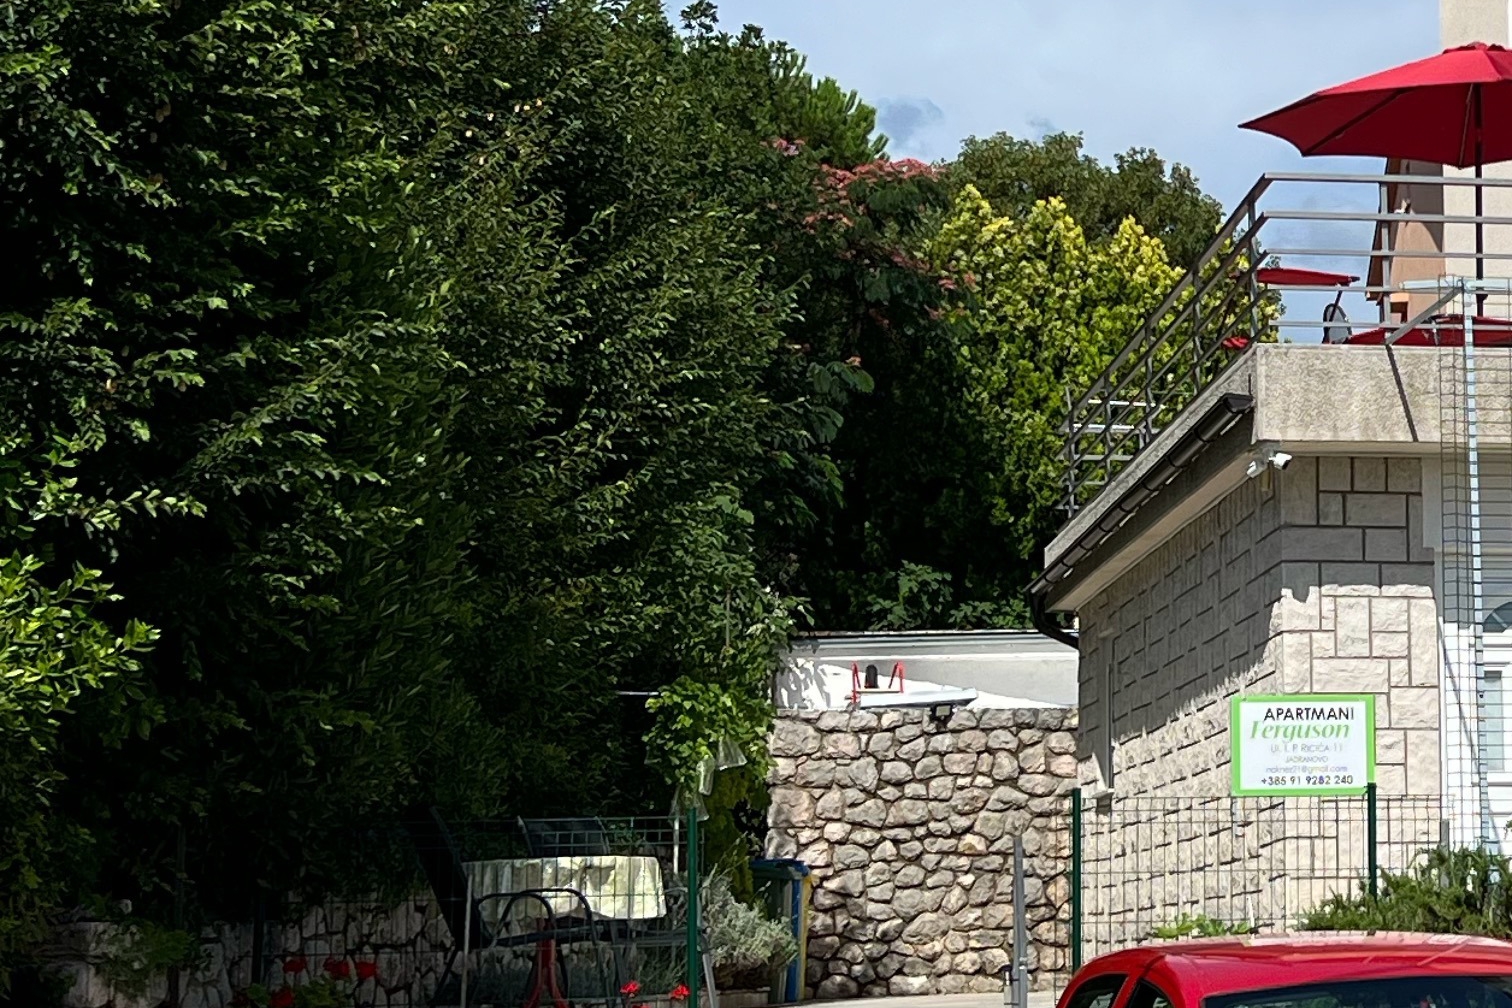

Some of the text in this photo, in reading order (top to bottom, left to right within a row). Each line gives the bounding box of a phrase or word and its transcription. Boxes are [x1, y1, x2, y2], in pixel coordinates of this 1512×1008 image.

[1264, 706, 1354, 721] APARTMANI
[1251, 720, 1350, 741] Ferguson
[1261, 775, 1353, 786] +385 91 9282 240
